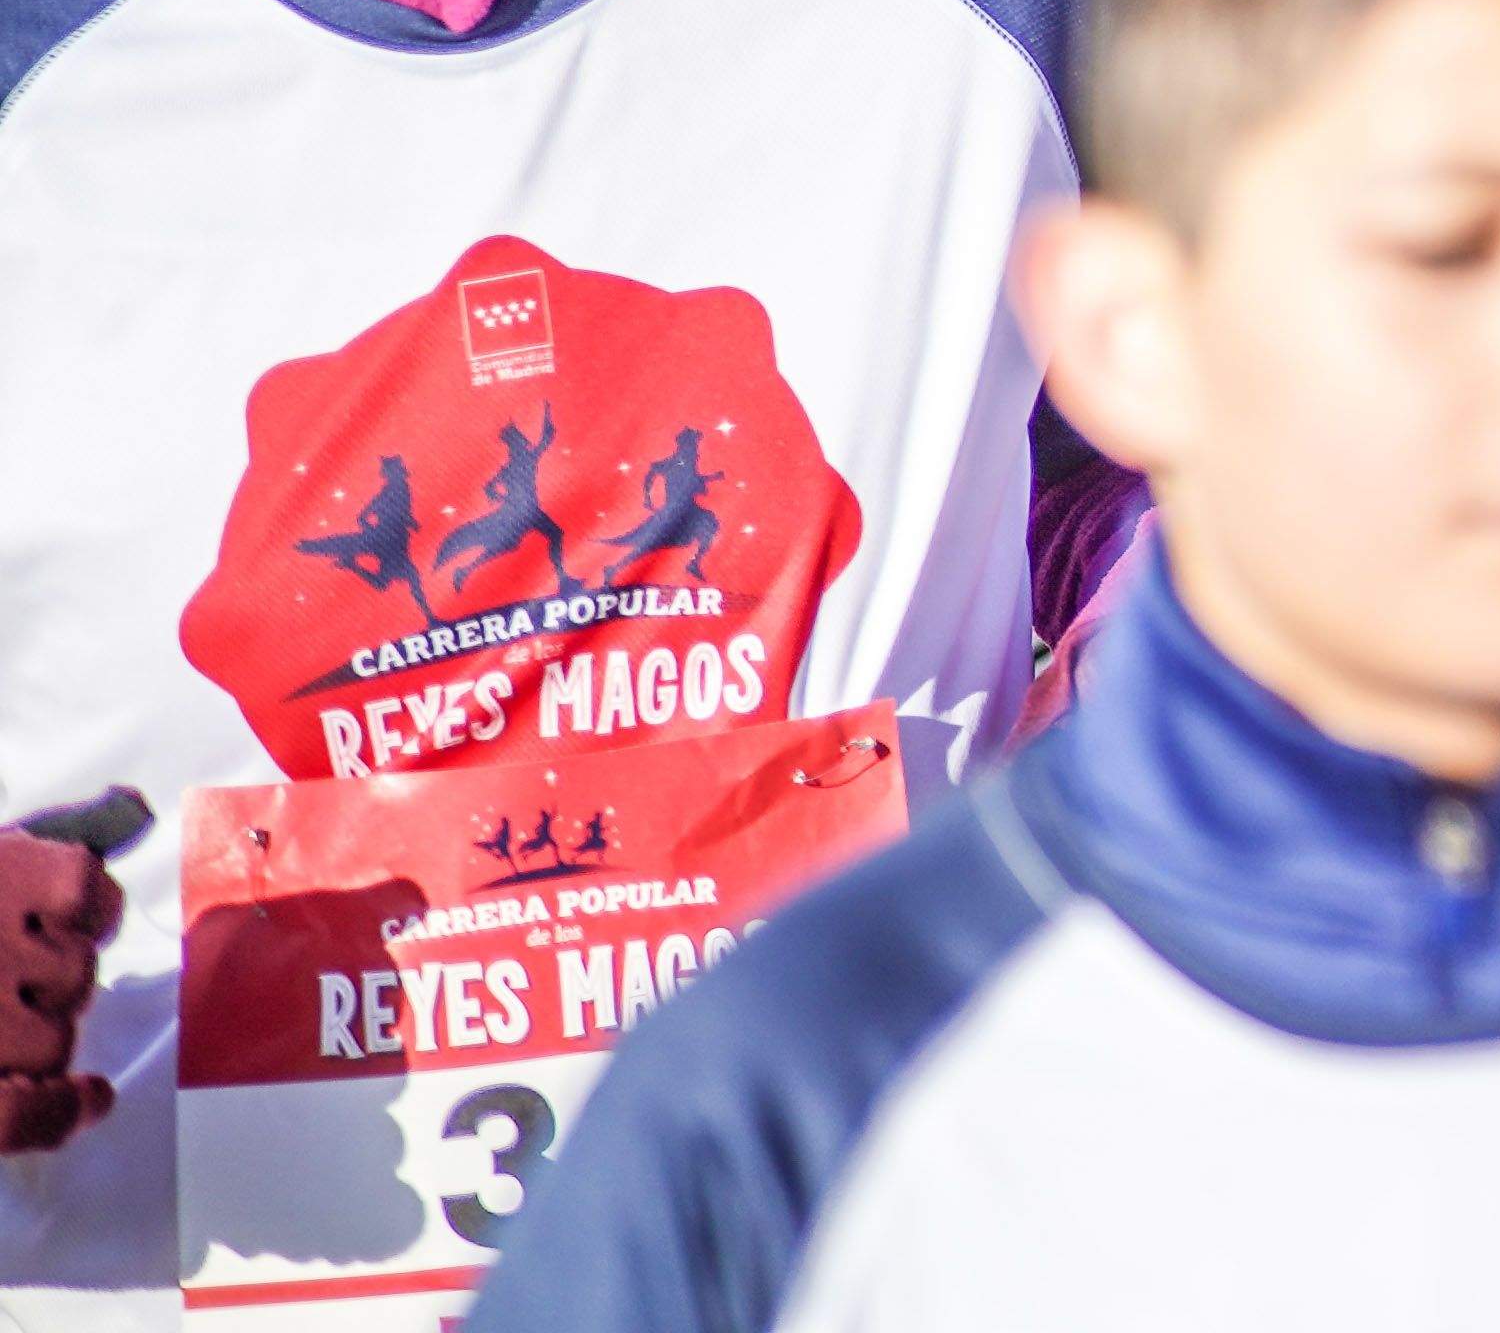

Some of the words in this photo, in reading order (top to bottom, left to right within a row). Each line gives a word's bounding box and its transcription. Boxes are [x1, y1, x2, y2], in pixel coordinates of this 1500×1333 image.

[351, 609, 534, 678] CARRERA
[543, 587, 723, 629] POPULAR
[504, 646, 530, 665] de
[321, 671, 513, 779] REYES
[539, 633, 766, 738] MAGOS
[380, 894, 549, 945] CARRERA
[557, 877, 718, 917] POPULAR
[526, 927, 552, 948] de
[555, 924, 583, 944] los
[318, 959, 530, 1060] REYES
